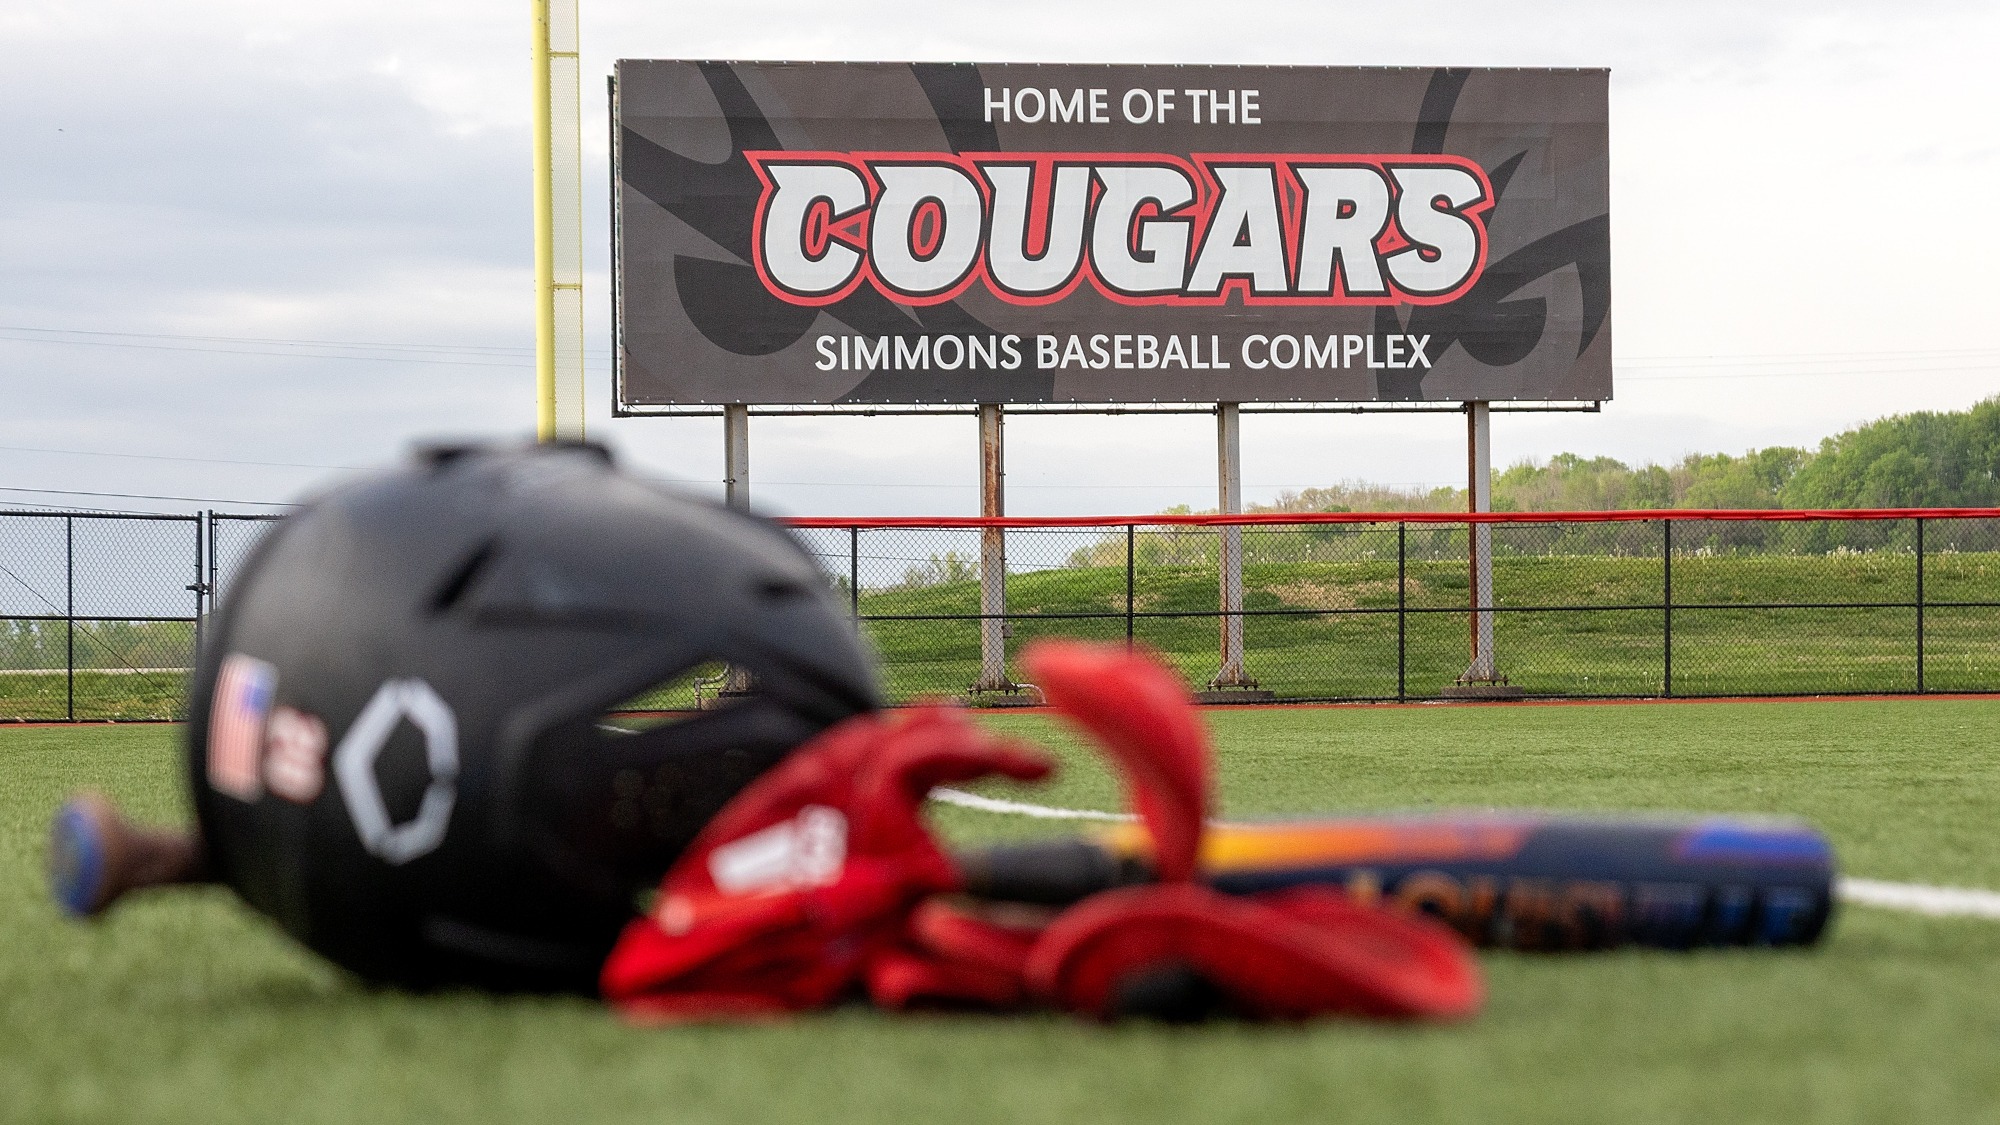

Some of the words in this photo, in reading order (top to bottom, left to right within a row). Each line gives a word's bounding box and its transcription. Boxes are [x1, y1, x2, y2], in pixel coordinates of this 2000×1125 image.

[984, 87, 1111, 124] HOME
[1122, 88, 1177, 124] OF
[1184, 89, 1262, 125] THE
[743, 150, 1495, 306] COUGARS
[815, 334, 1022, 371] SIMMONS
[1036, 334, 1231, 370] BASEBALL
[1241, 334, 1432, 370] COMPLEX
